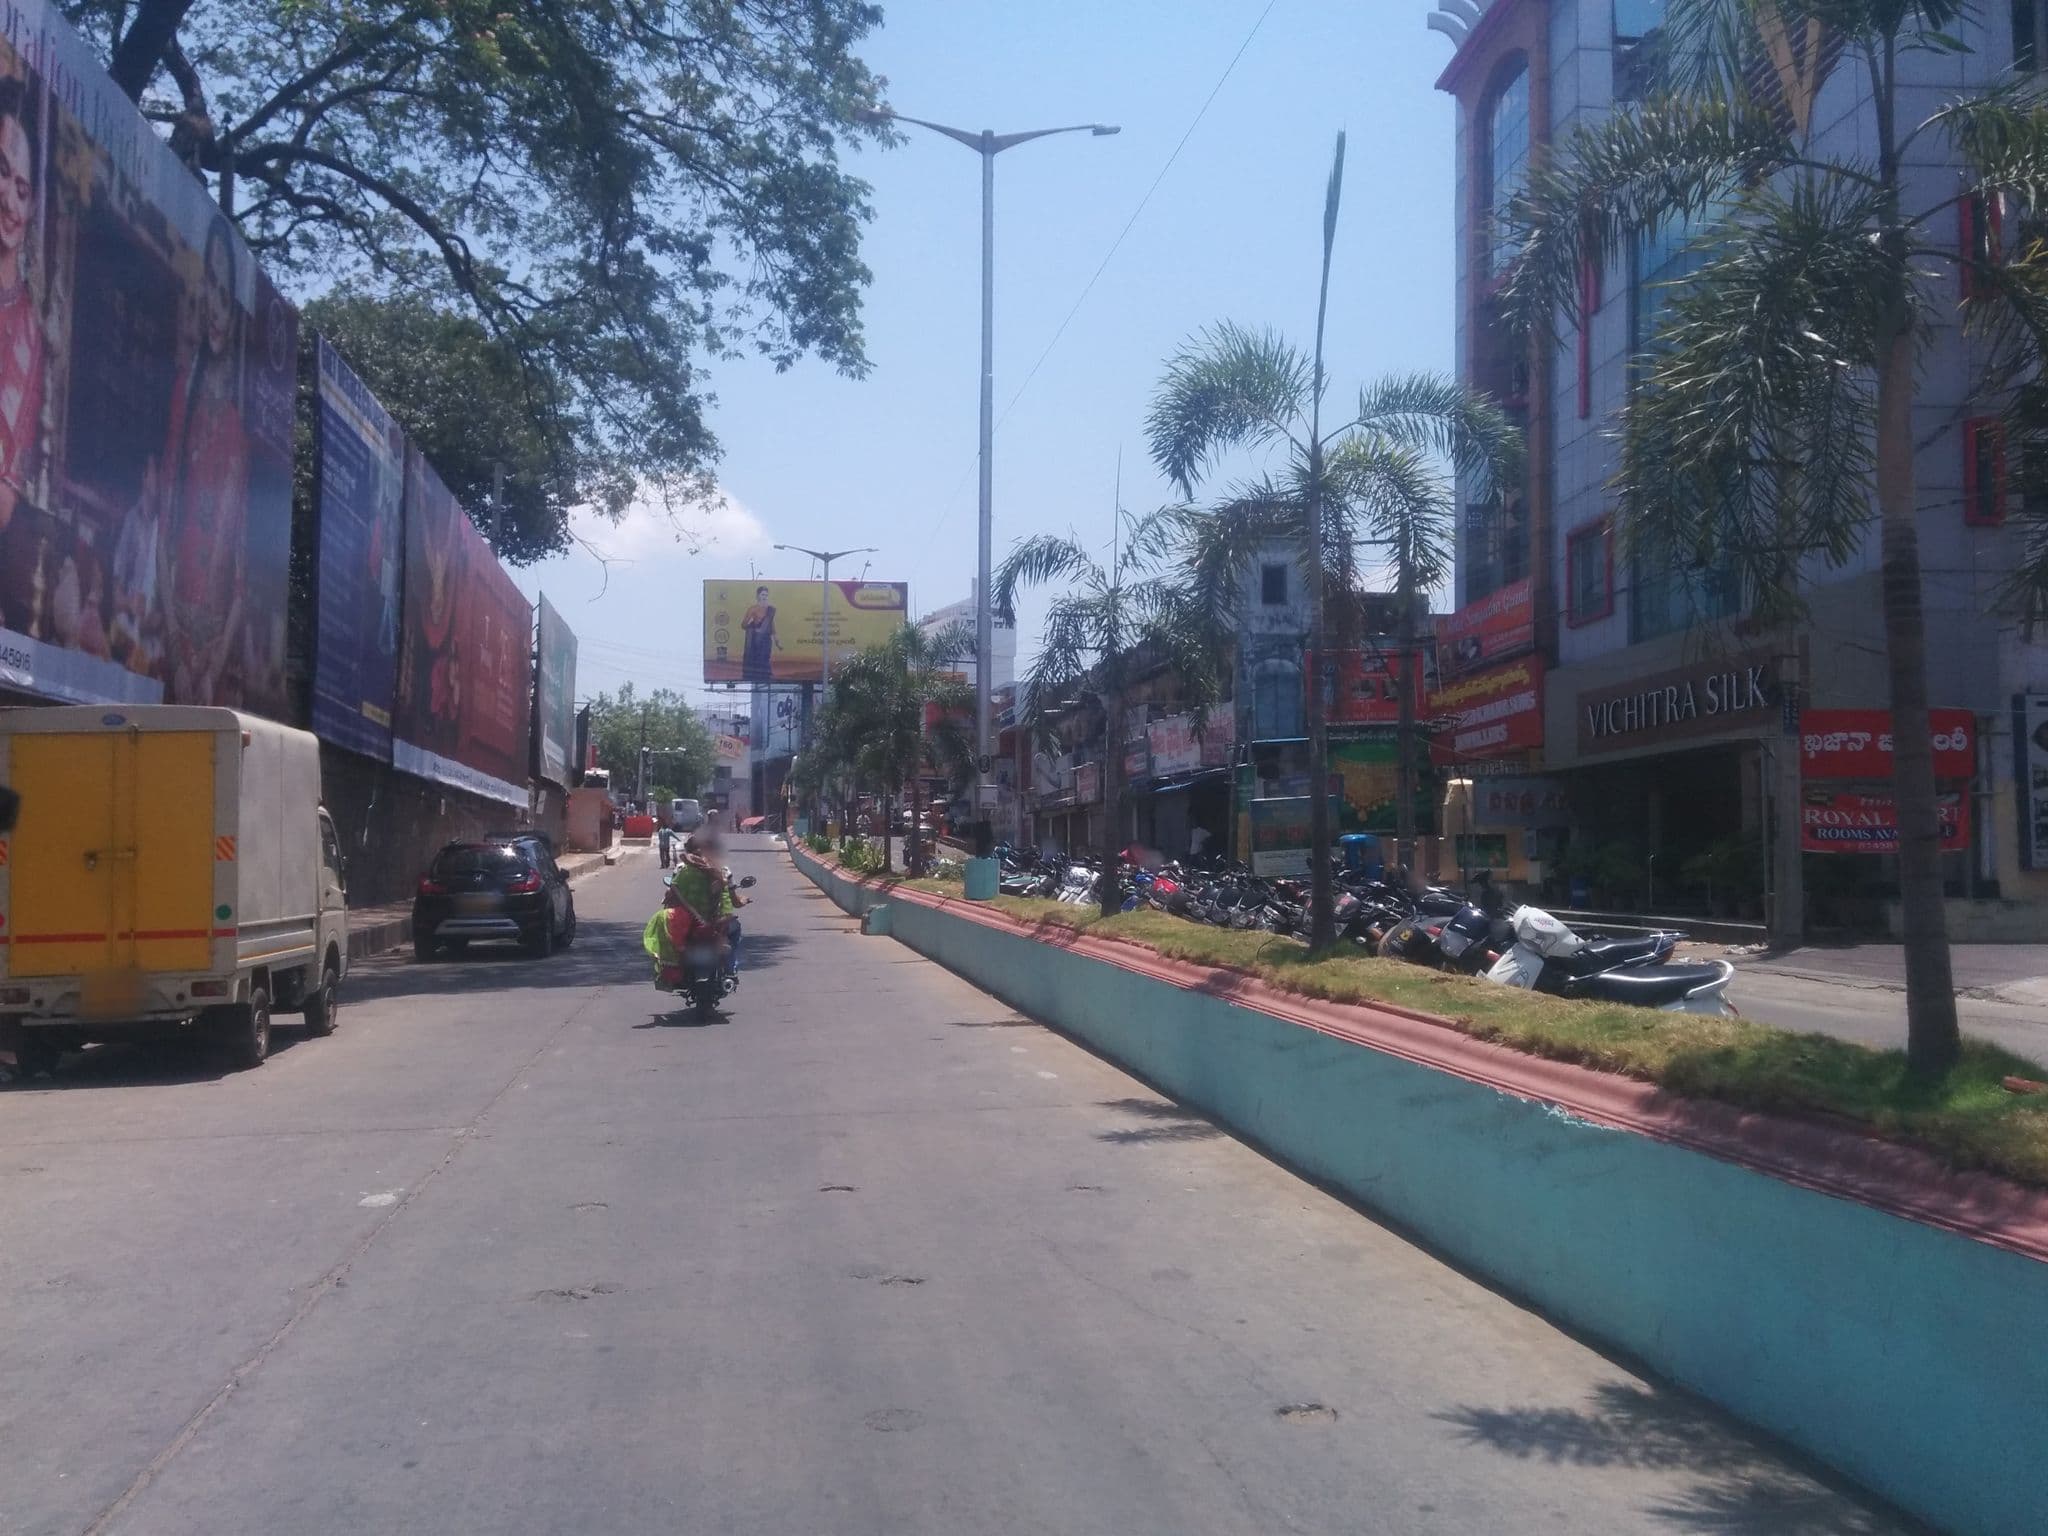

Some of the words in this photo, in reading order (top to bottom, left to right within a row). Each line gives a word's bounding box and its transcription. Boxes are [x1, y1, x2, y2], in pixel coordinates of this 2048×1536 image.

[1588, 681, 1697, 737] VICHITRA
[1706, 664, 1769, 715] SILK
[1803, 808, 1890, 826] ROYAL
[1816, 827, 1872, 840] ROOMS
